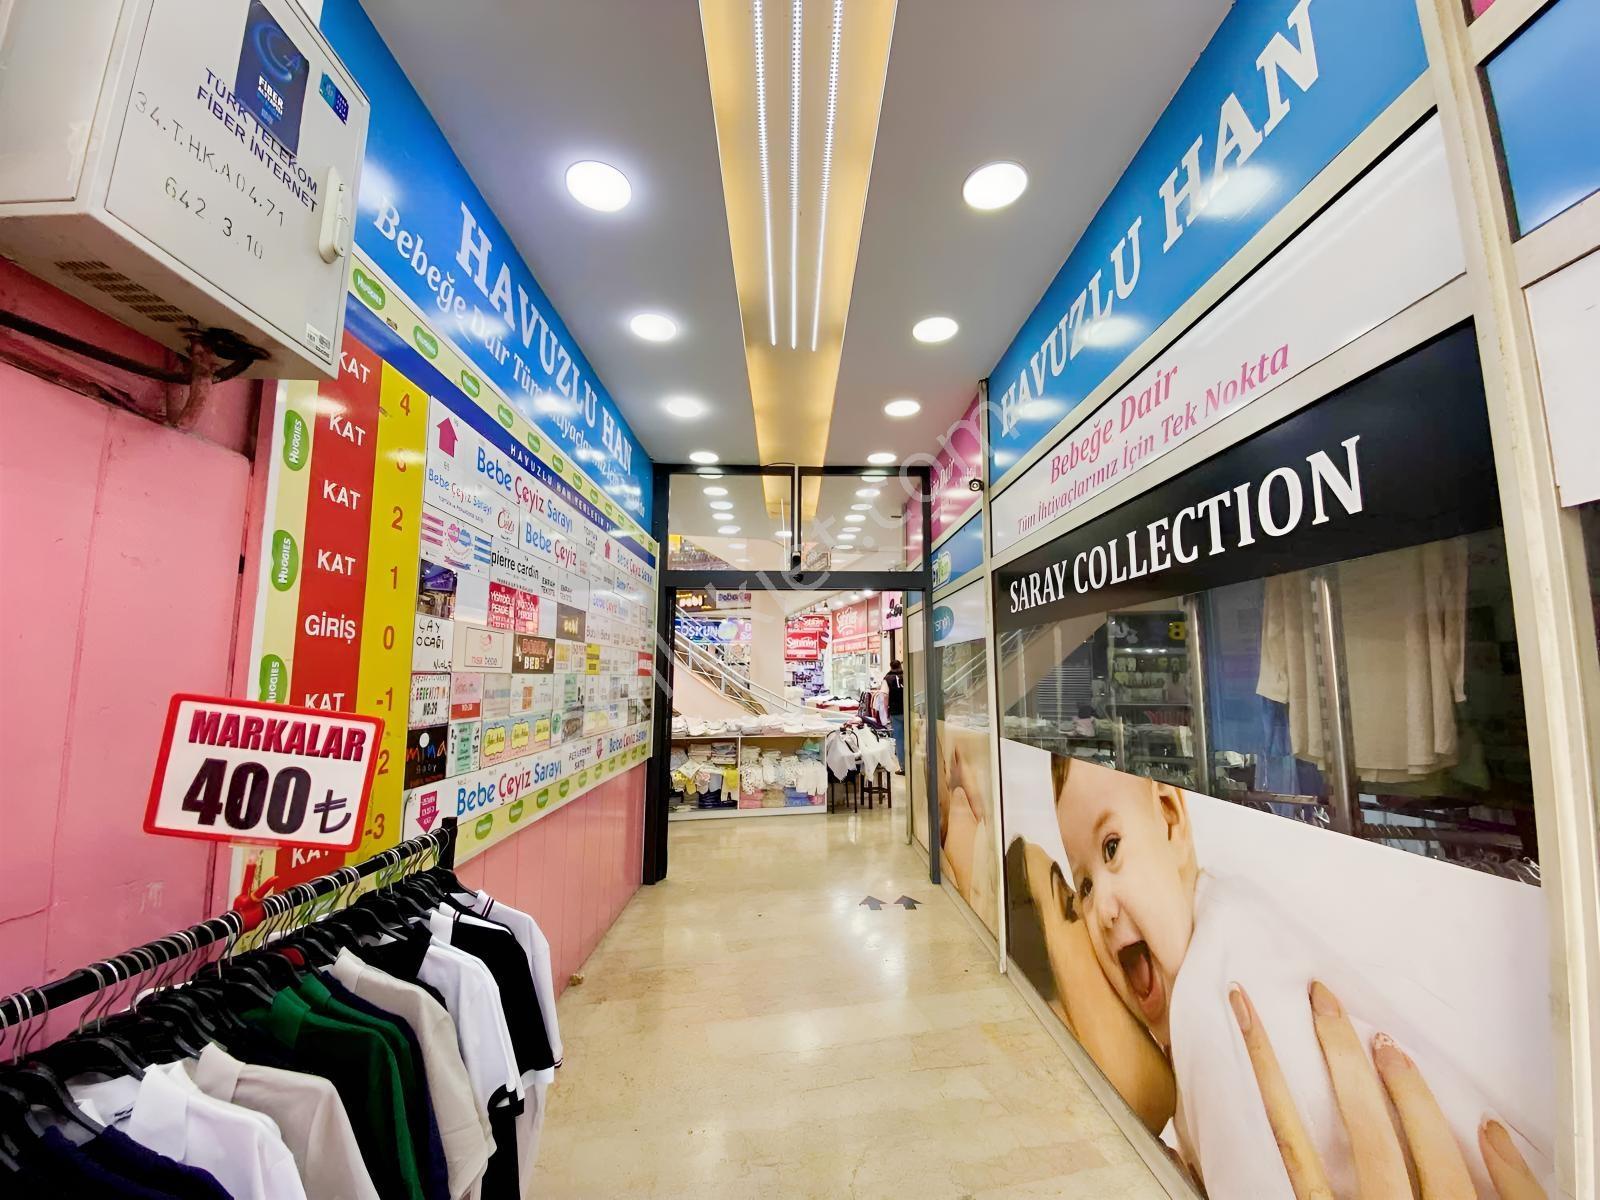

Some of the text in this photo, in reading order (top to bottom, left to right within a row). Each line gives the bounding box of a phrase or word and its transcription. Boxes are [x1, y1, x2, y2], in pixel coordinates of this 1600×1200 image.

[196, 84, 247, 146] FİBER
[249, 134, 319, 214] İNTERNET
[206, 66, 319, 196] TÜRK TELEKOM
[1001, 0, 1319, 438] HAVUZLU HAN
[373, 197, 467, 320] Bebeğe
[455, 200, 599, 430] HAVUZLU
[601, 405, 634, 477] HAN
[399, 393, 411, 417] 4
[1050, 365, 1178, 485] Bebeğe Dair
[329, 412, 367, 447] KAT
[1017, 513, 1036, 535] Tüm
[1122, 434, 1155, 473] İçin
[1161, 401, 1198, 445] Tek
[1203, 343, 1290, 421] Nokta
[323, 479, 361, 511] KAT
[476, 445, 512, 492] Bebe
[514, 475, 545, 514] Çeyiz
[391, 505, 404, 532] 2
[1009, 433, 1364, 614] SARAY COLLECTION
[277, 536, 292, 585] HUGGIES
[318, 548, 357, 576] KAT
[491, 550, 539, 581] pierre cardin
[525, 521, 552, 554] Bebe
[554, 538, 577, 569] Çeyiz
[390, 566, 399, 590] 1
[304, 610, 357, 645] GİRİŞ
[383, 625, 395, 651] 0
[268, 660, 281, 703] UGGIES
[304, 692, 345, 712] KAT
[376, 687, 393, 712] -1
[187, 708, 367, 762] MARKALAR
[456, 781, 496, 817] Bebe
[498, 766, 532, 806] Çeyiz
[534, 759, 562, 785] Sarayı
[364, 813, 386, 840] -3
